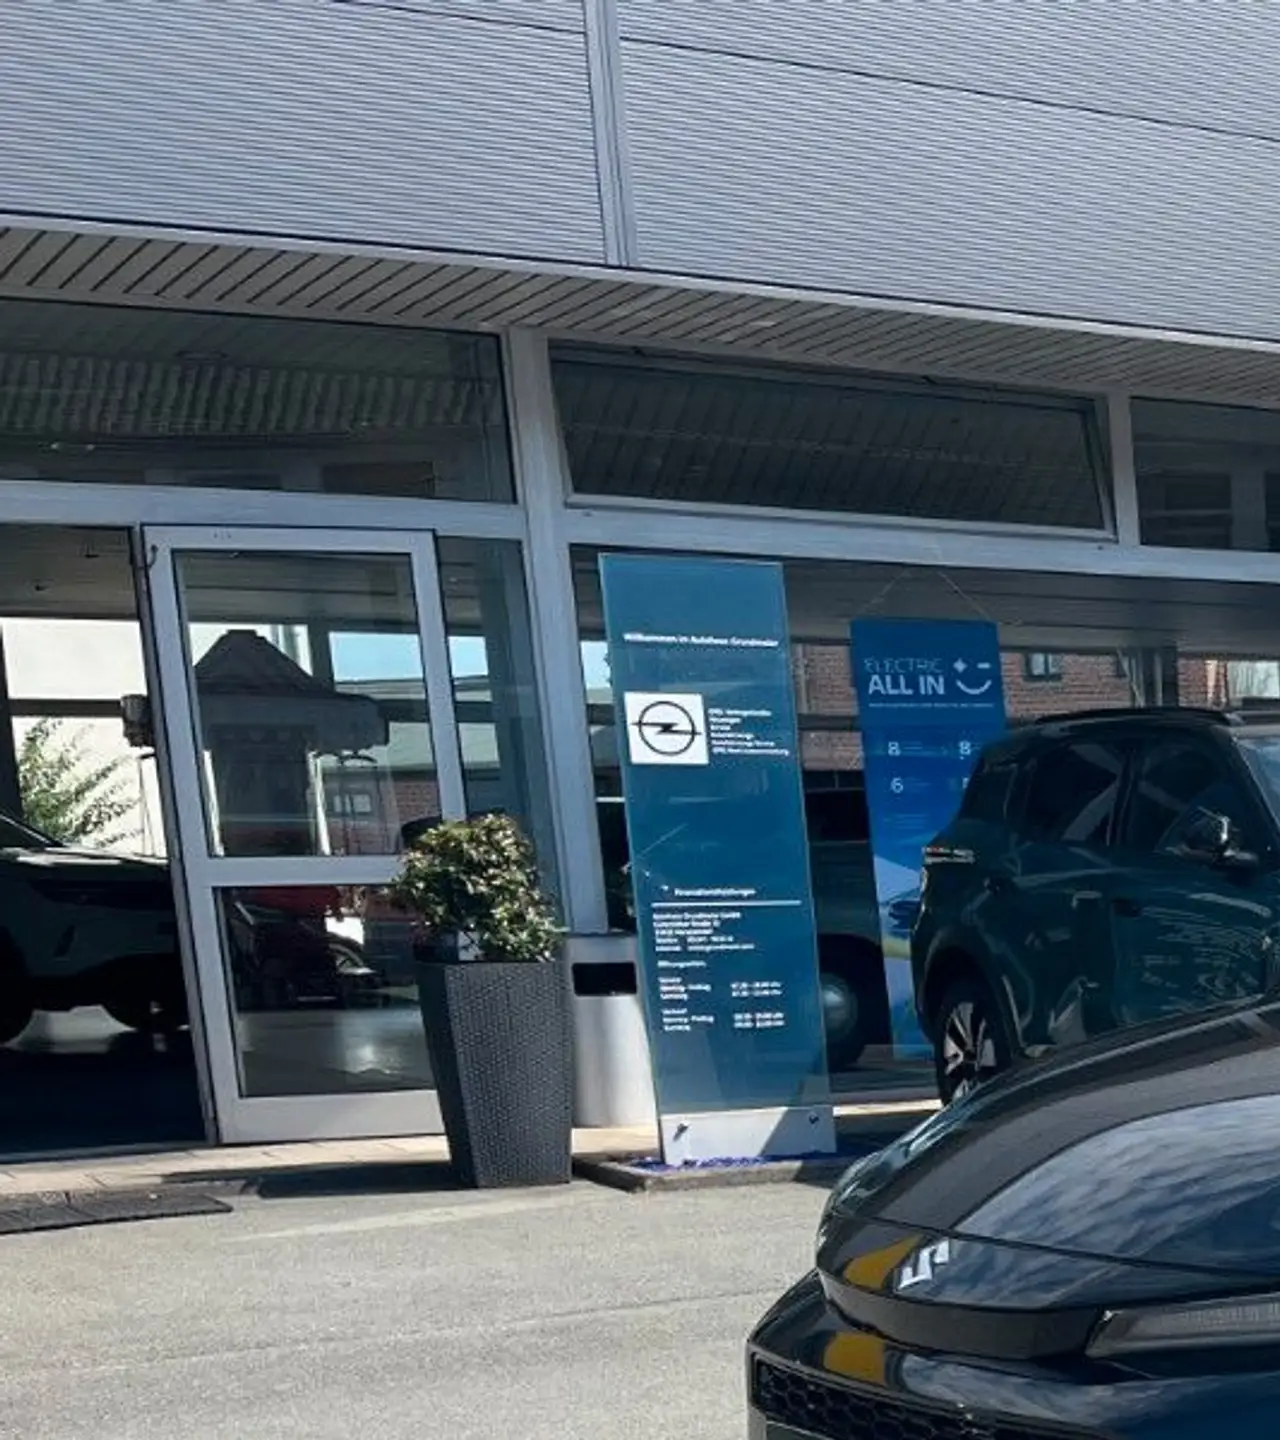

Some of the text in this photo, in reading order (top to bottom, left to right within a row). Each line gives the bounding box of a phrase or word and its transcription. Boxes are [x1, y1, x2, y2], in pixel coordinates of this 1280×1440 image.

[864, 657, 943, 674] ELECTRIC
[868, 675, 946, 695] ALL IN
